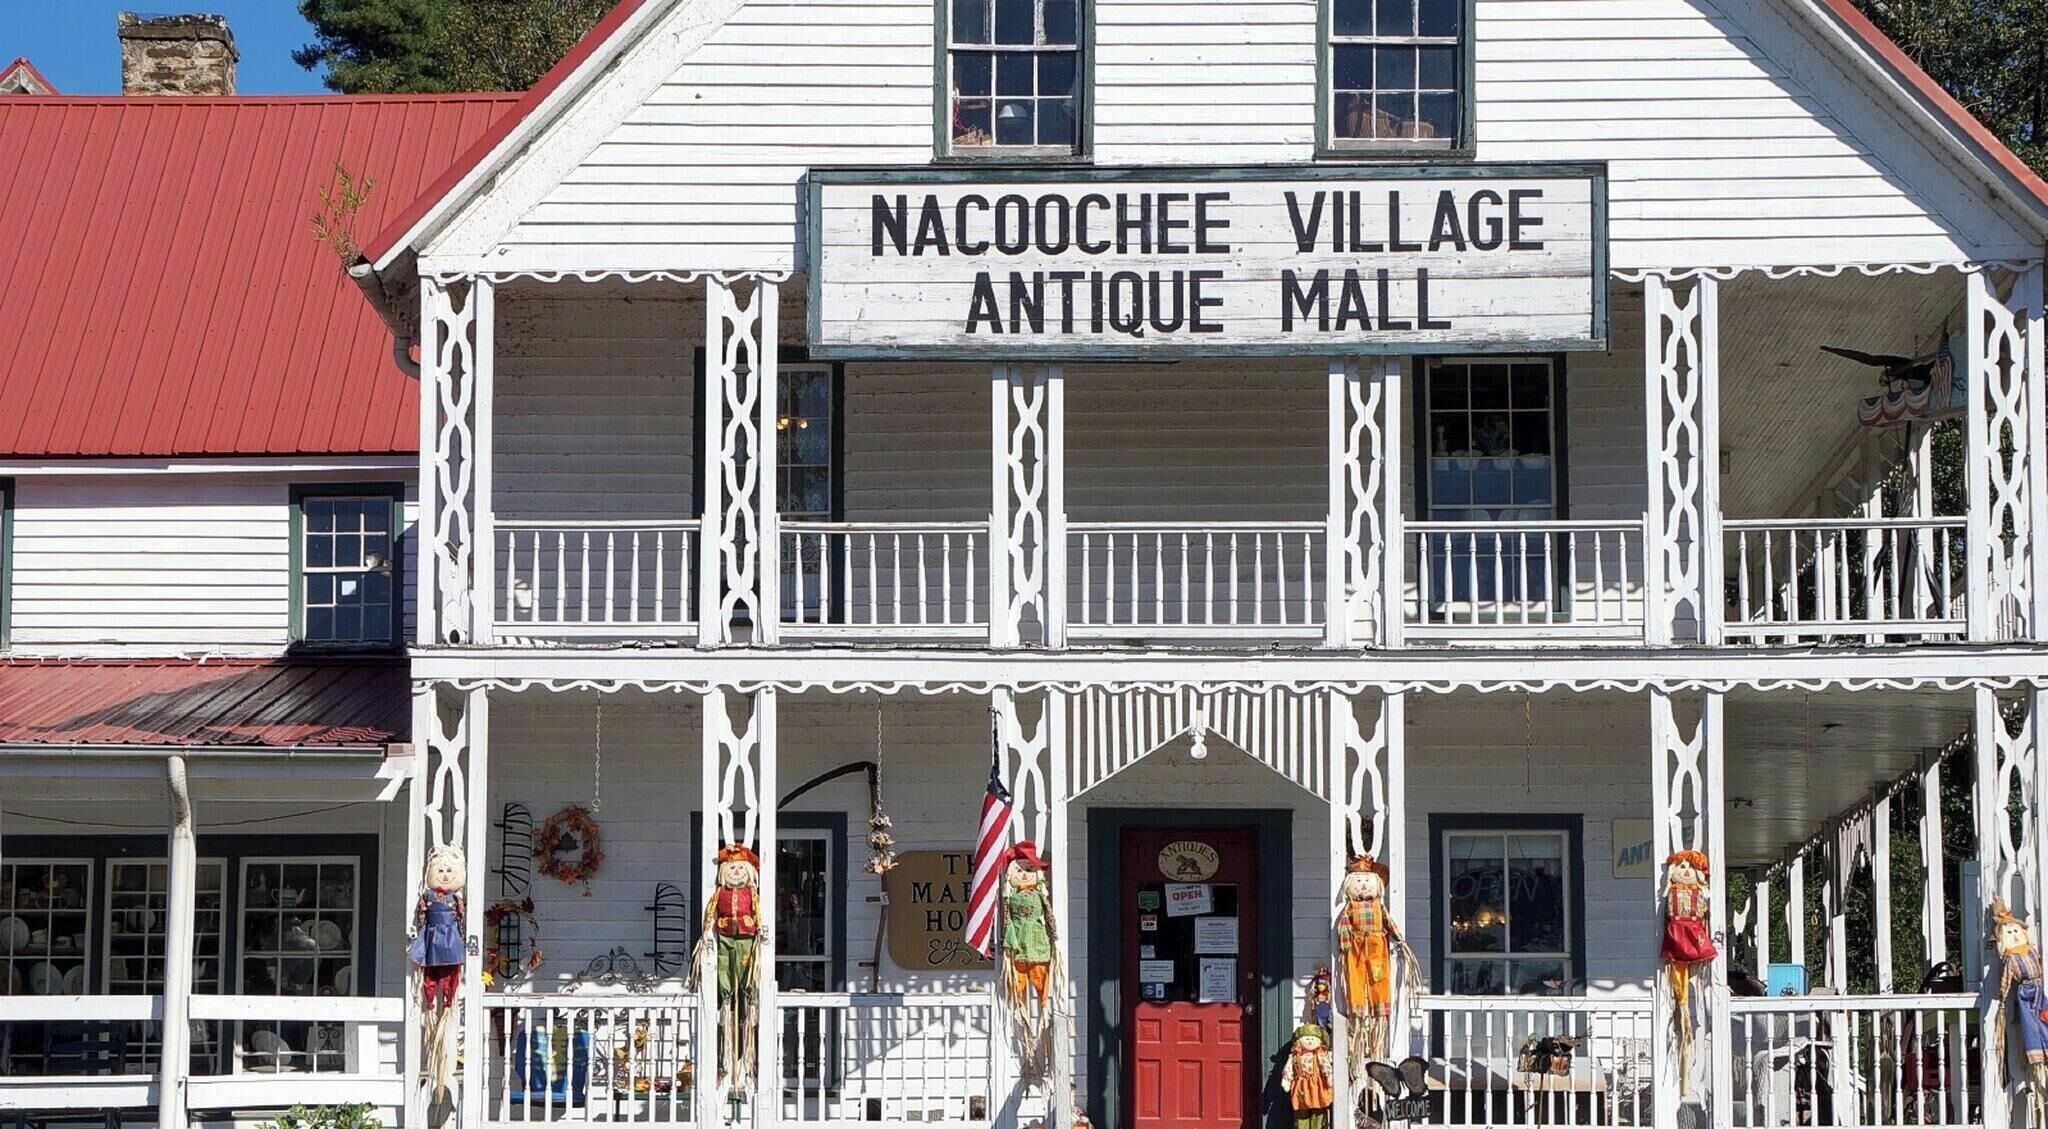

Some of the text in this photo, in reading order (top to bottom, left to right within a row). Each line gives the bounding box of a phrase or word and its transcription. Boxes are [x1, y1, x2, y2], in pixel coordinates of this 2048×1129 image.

[871, 188, 1544, 257] NACOOCHEE VILLAGE
[965, 267, 1453, 338] ANTIQUE MALL
[1160, 841, 1217, 863] ANTIQUES
[1172, 890, 1202, 901] OPEN
[1386, 1099, 1432, 1119] WELCOME
